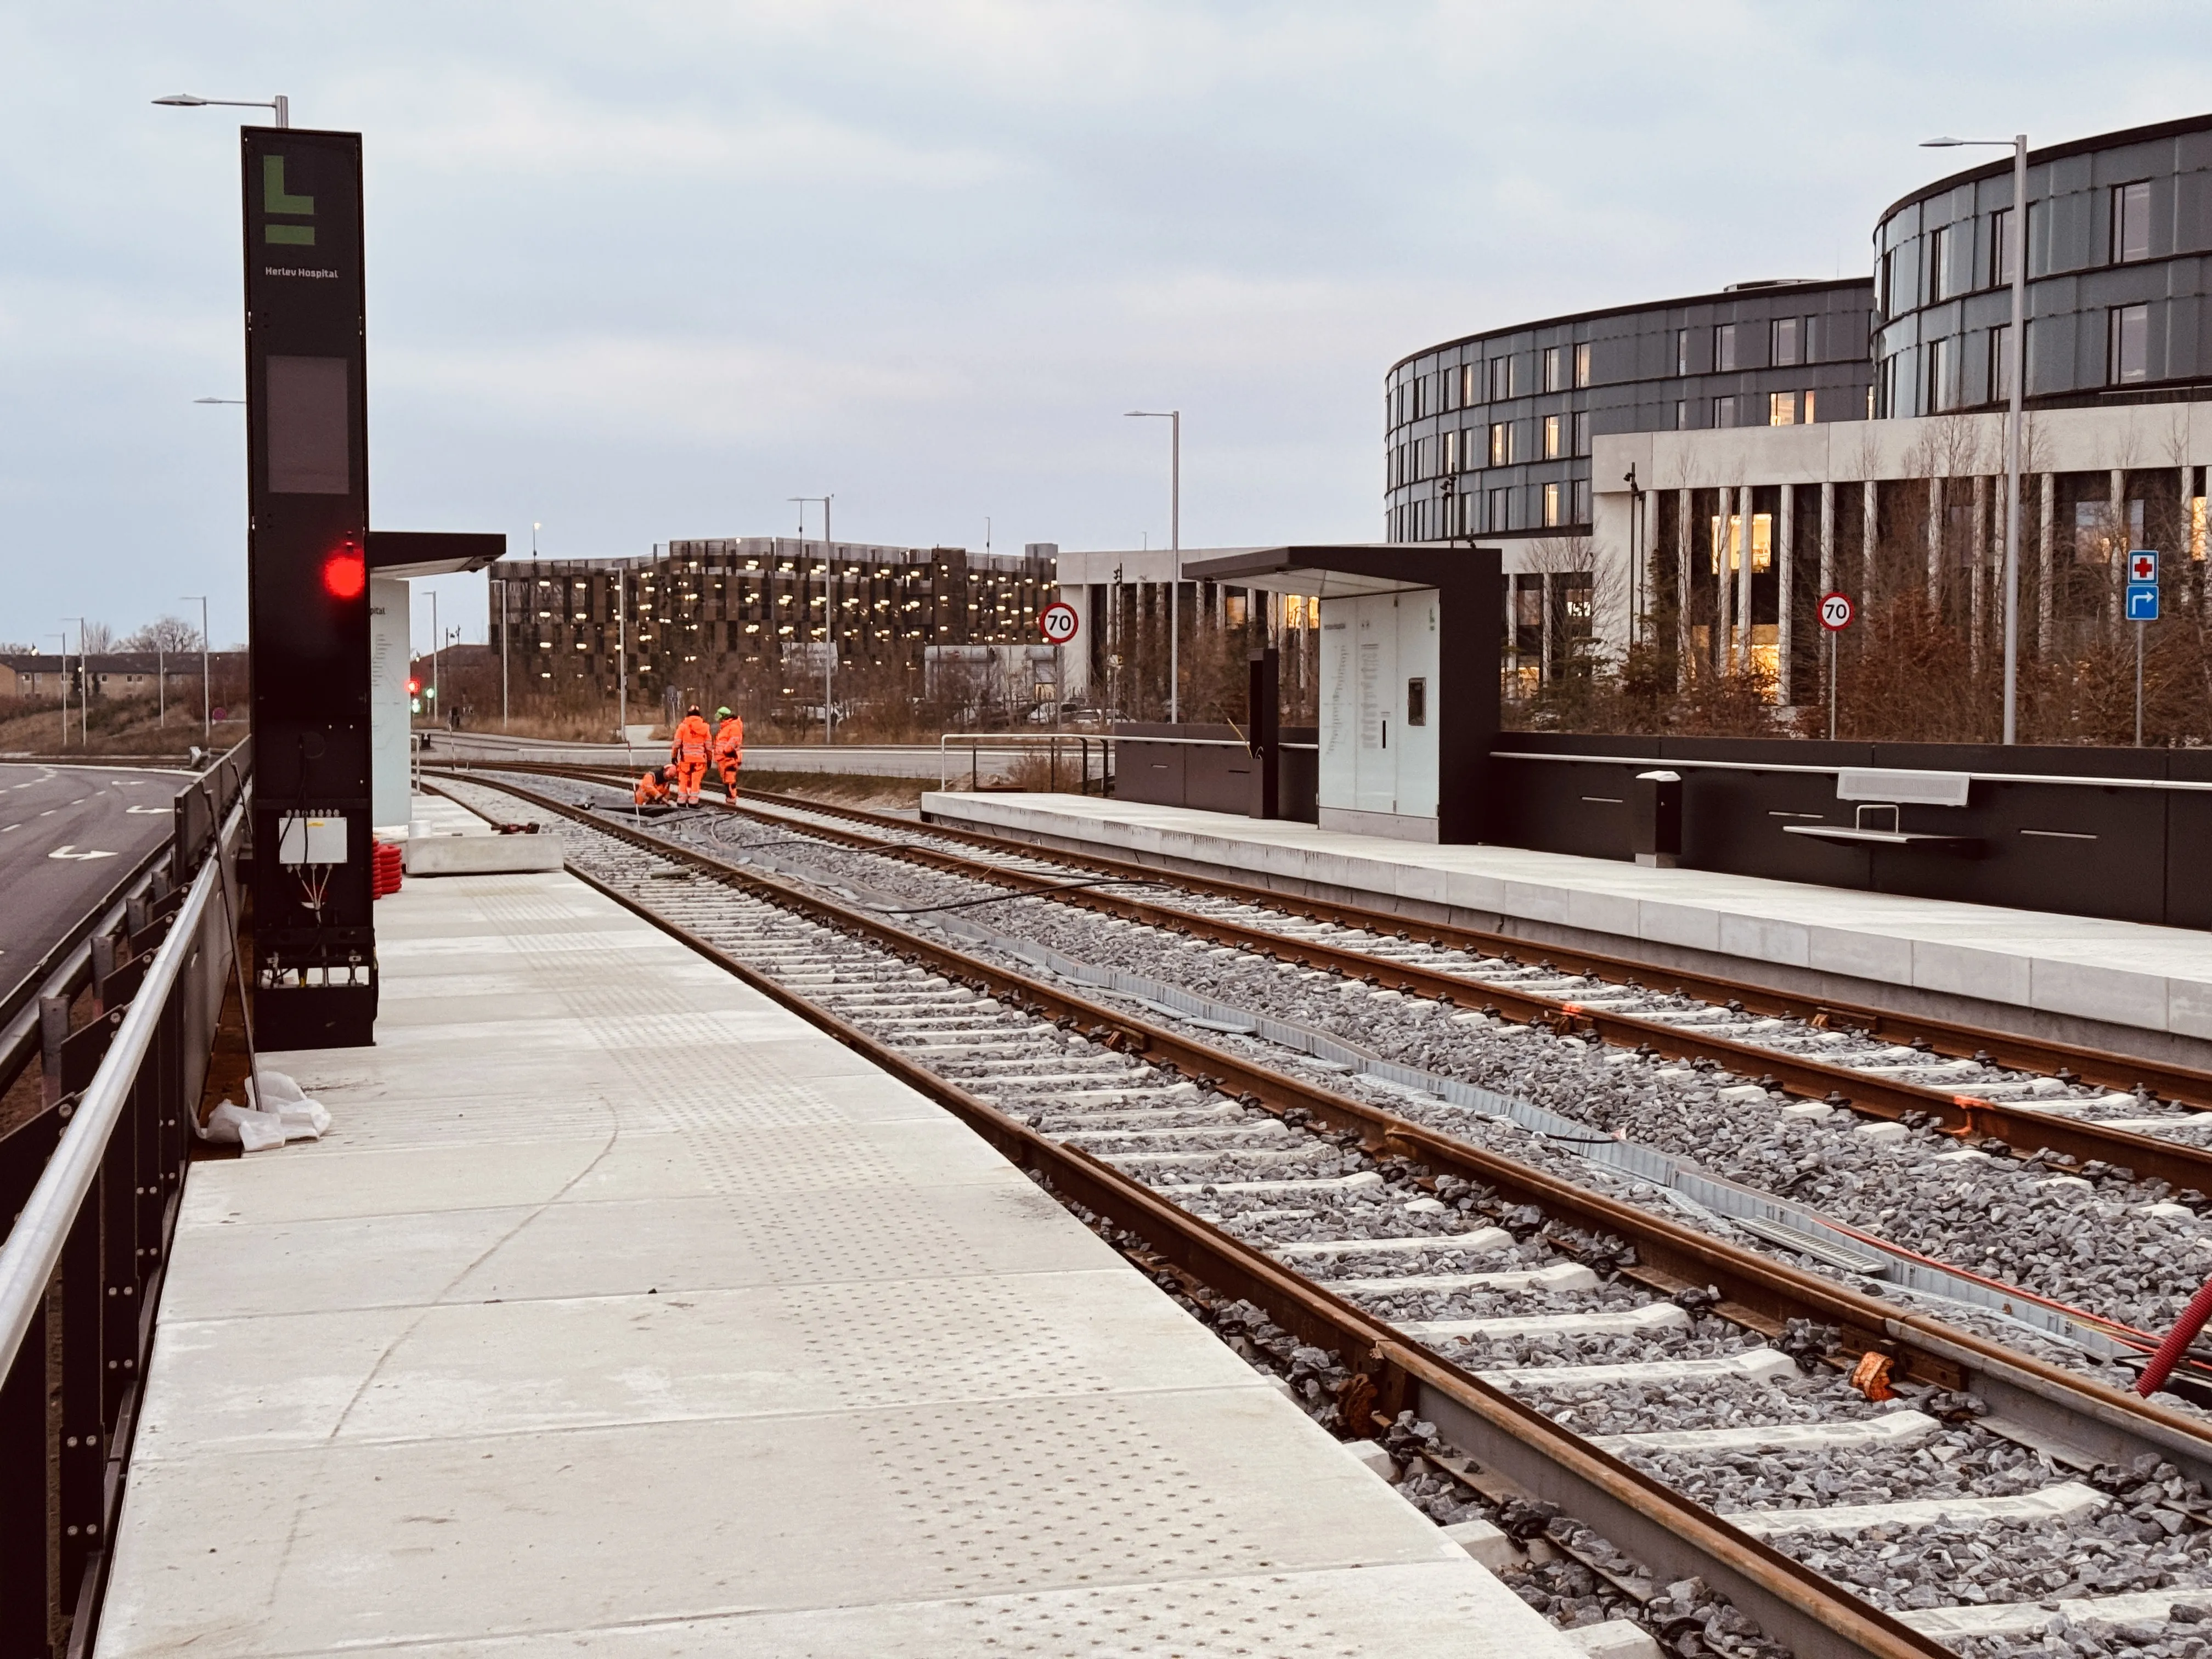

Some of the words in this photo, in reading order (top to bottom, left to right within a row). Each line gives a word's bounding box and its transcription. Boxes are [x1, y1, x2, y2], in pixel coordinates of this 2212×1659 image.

[266, 267, 296, 276] Herlev
[298, 268, 338, 279] Hospital
[1825, 604, 1847, 619] 70
[1048, 615, 1071, 631] 70
